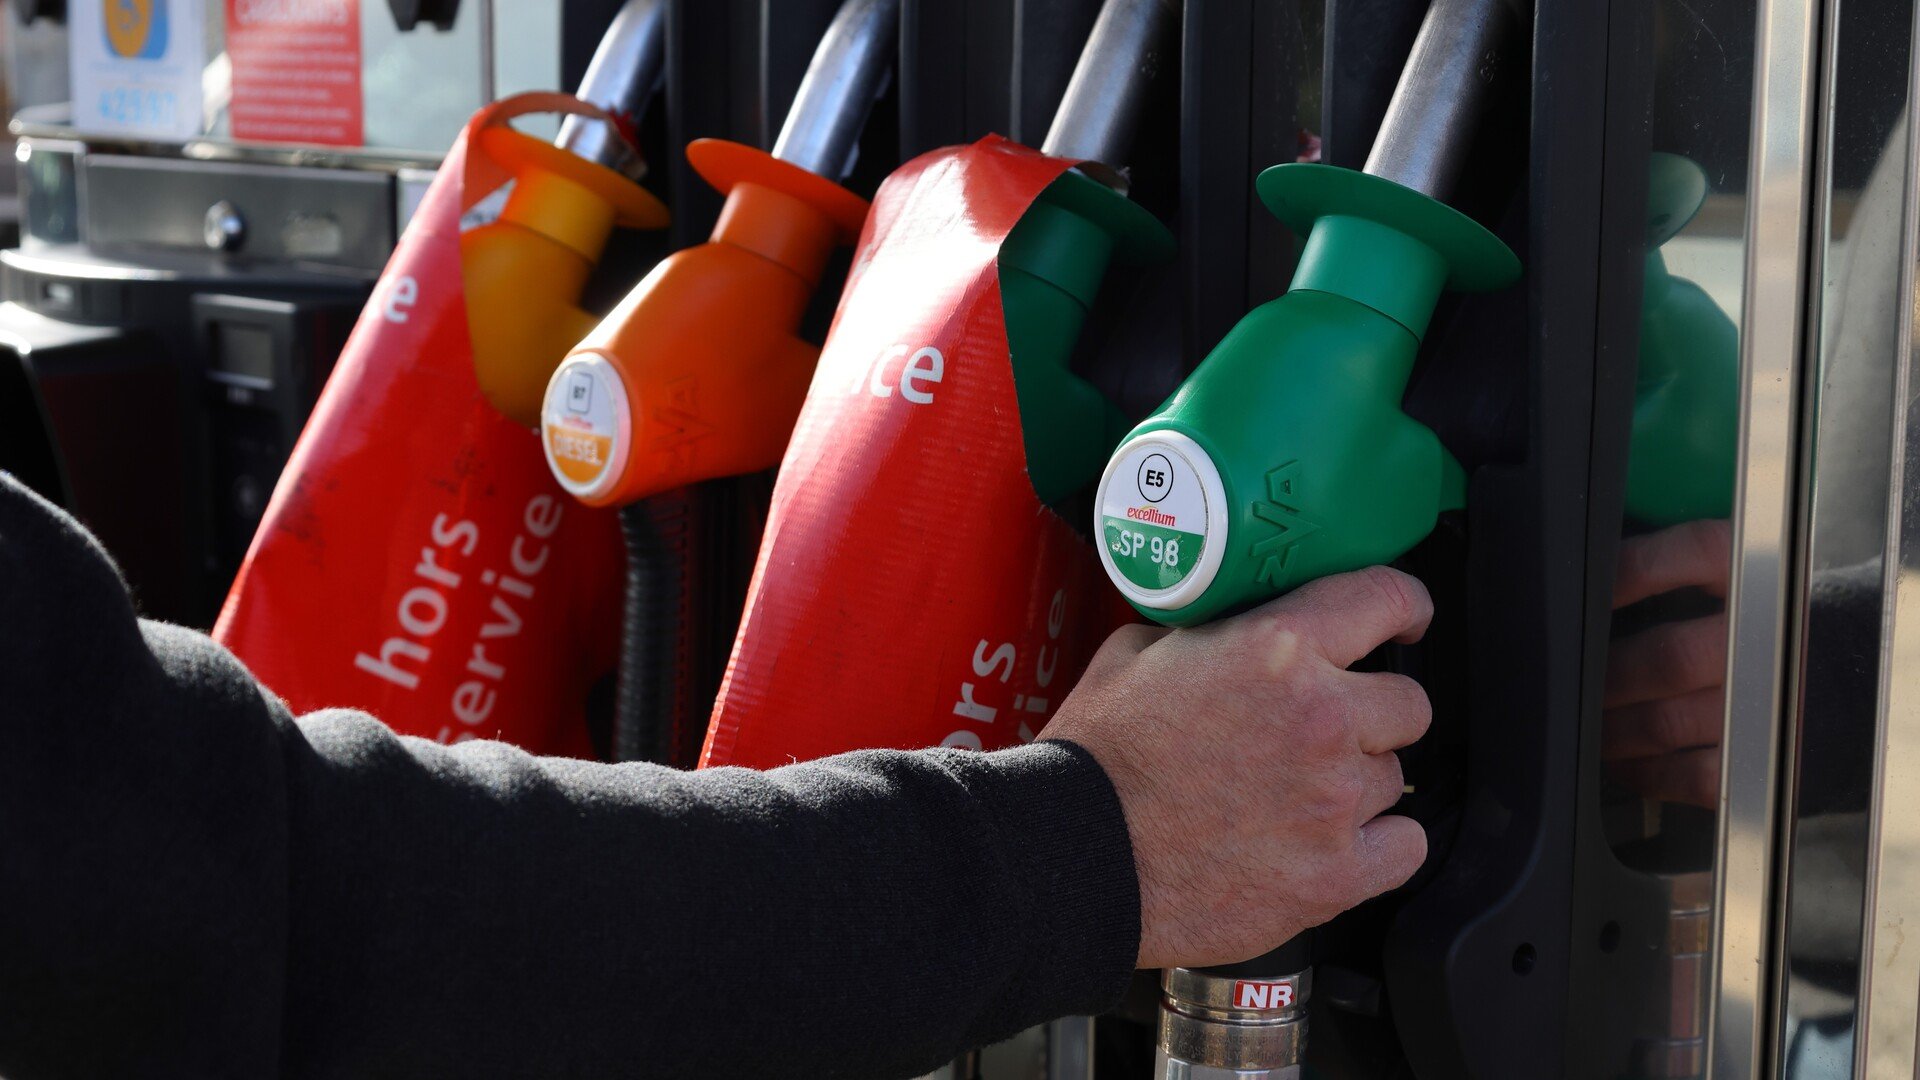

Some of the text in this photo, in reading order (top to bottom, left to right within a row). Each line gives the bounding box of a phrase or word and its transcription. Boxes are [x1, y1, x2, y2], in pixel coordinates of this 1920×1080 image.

[554, 432, 602, 466] DIESEL
[1145, 469, 1164, 488] E5
[1126, 505, 1176, 527] excellium
[1119, 529, 1179, 567] SP 98
[354, 512, 479, 690] hors
